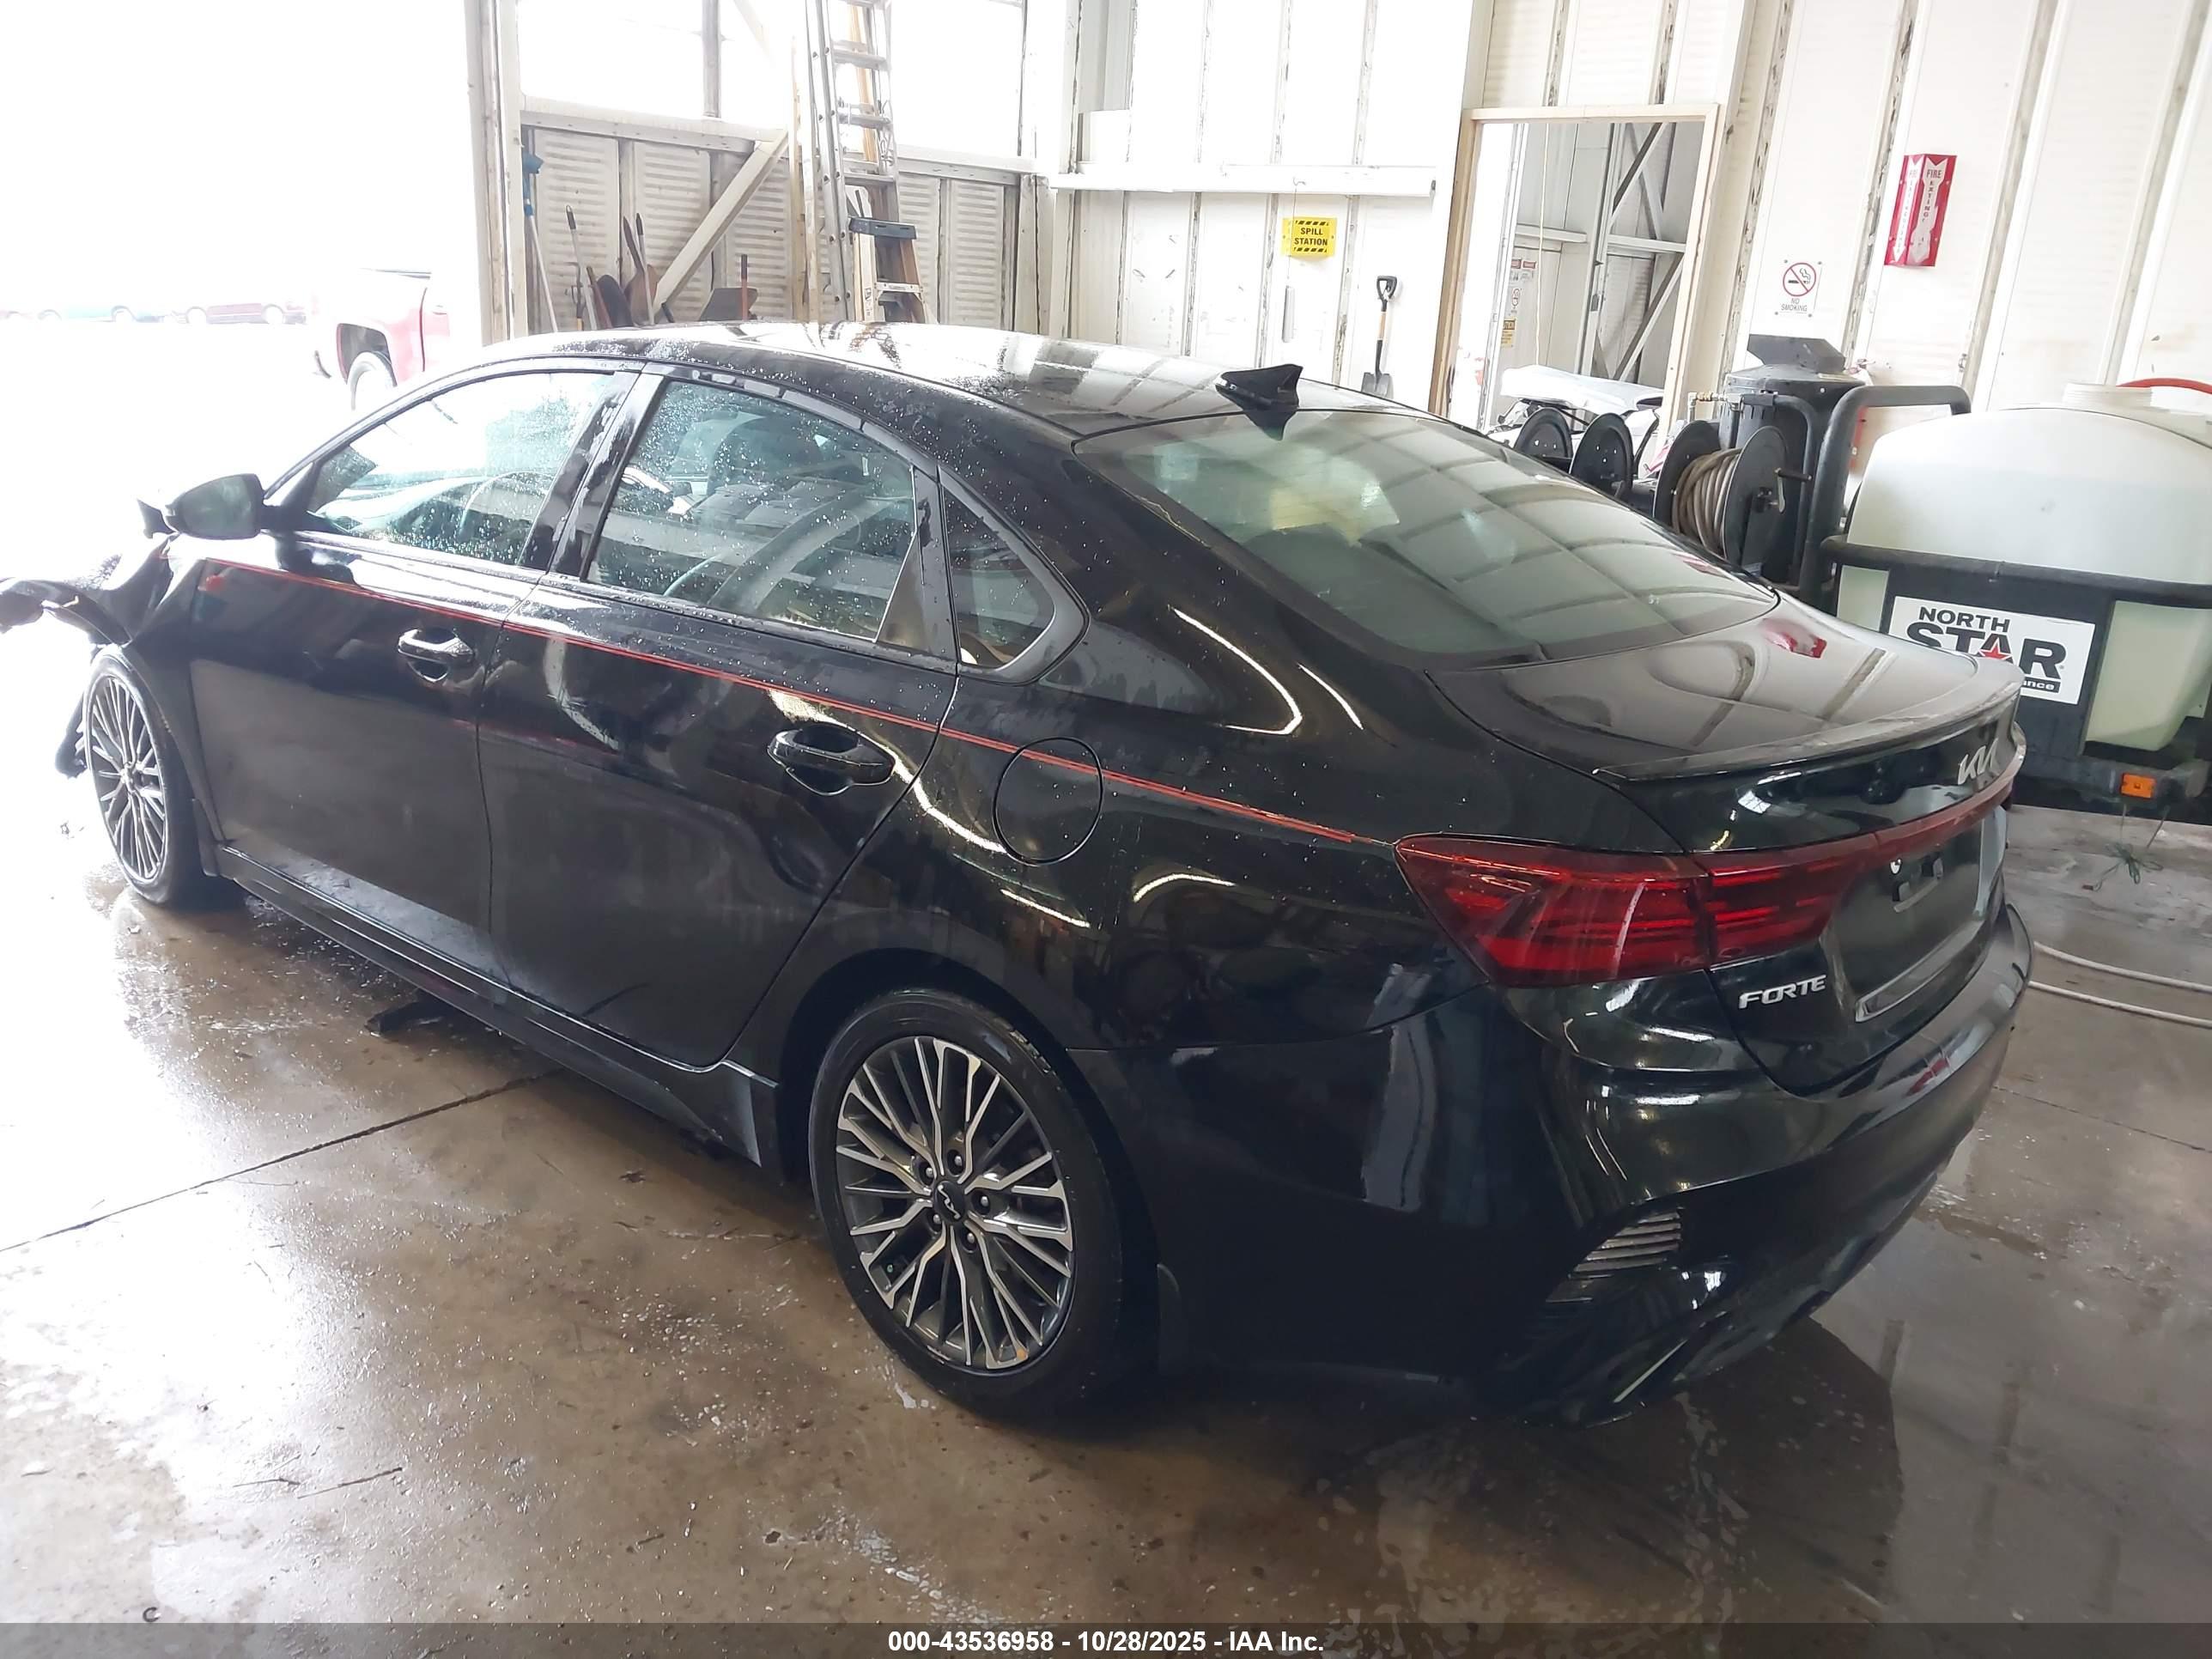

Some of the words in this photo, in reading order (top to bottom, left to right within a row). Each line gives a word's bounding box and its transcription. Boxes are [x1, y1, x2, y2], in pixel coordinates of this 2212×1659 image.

[1926, 169, 1942, 179] FIRE
[1300, 227, 1323, 235] SPILL
[1780, 303, 1808, 313] SMOKING
[1918, 605, 2011, 633] NORTH
[1906, 622, 2067, 680] STAR
[1738, 974, 1827, 1009] FORTE
